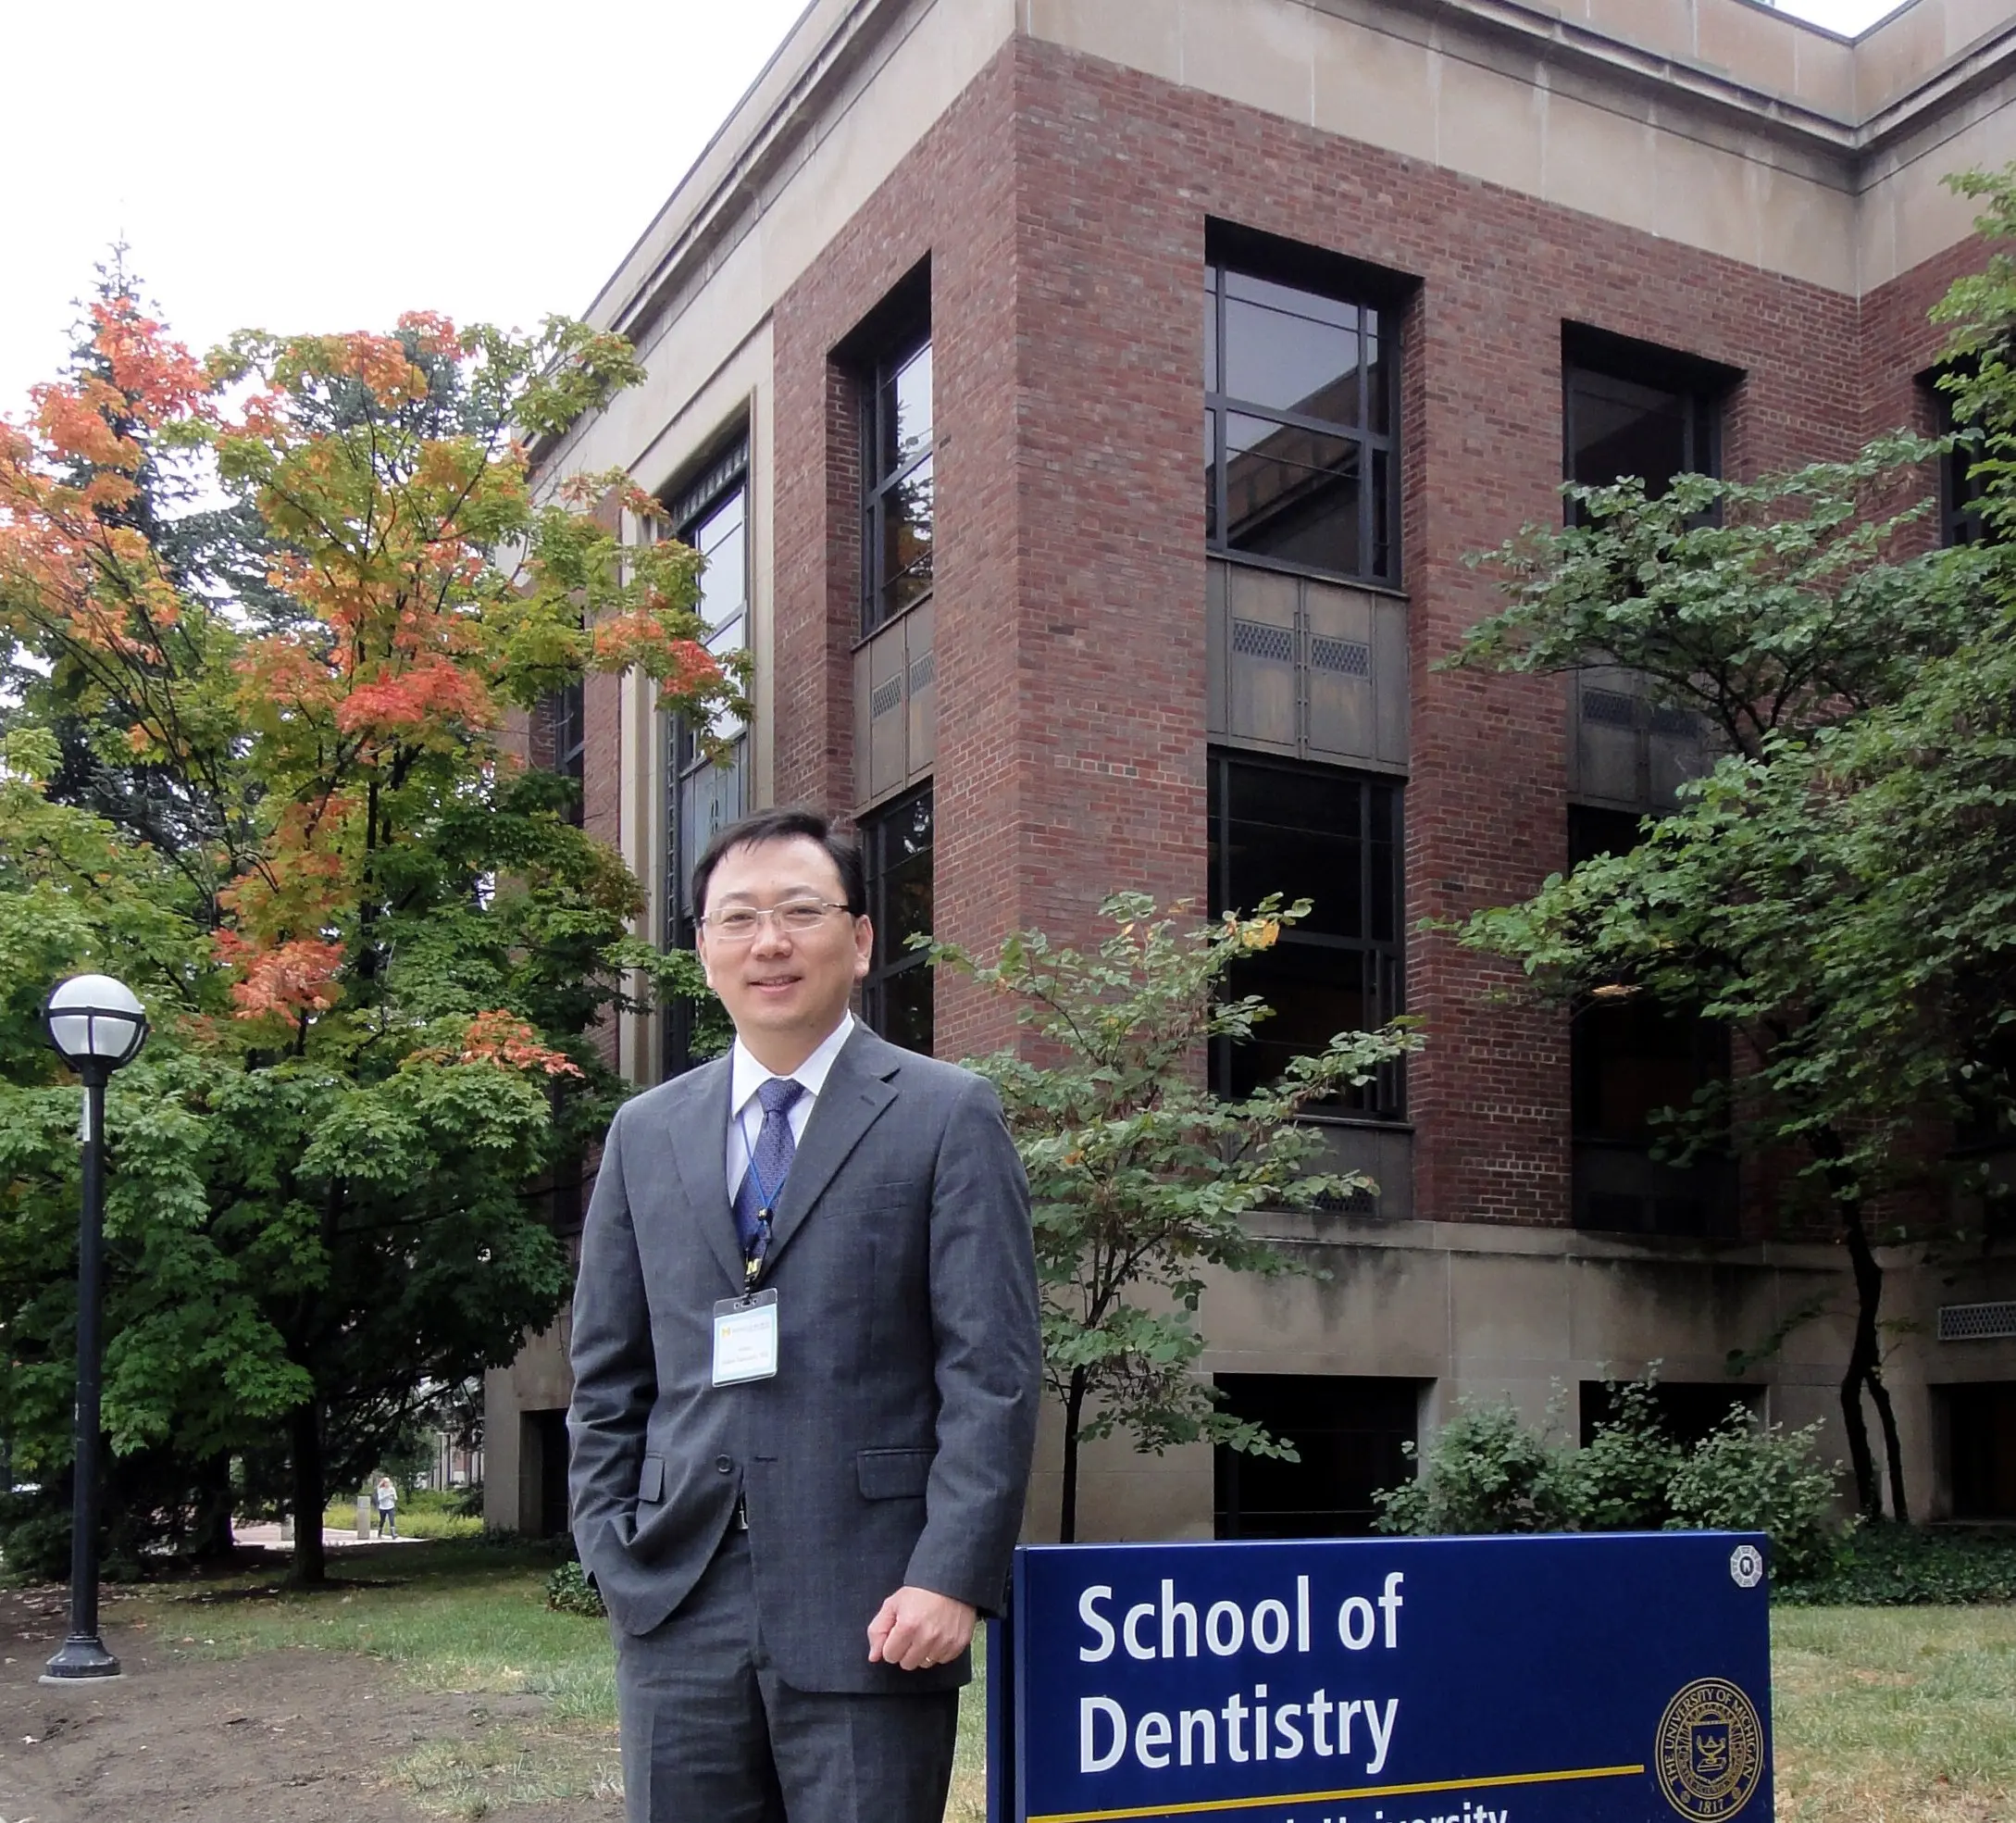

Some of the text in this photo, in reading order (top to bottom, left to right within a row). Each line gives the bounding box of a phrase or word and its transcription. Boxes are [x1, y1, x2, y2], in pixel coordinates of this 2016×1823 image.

[1078, 1571, 1404, 1663] School of
[1080, 1683, 1400, 1775] Dentistry
[1664, 1688, 1757, 1786] THE UNIVERSITY OF MICHIGAN
[1698, 1799, 1724, 1814] 1817
